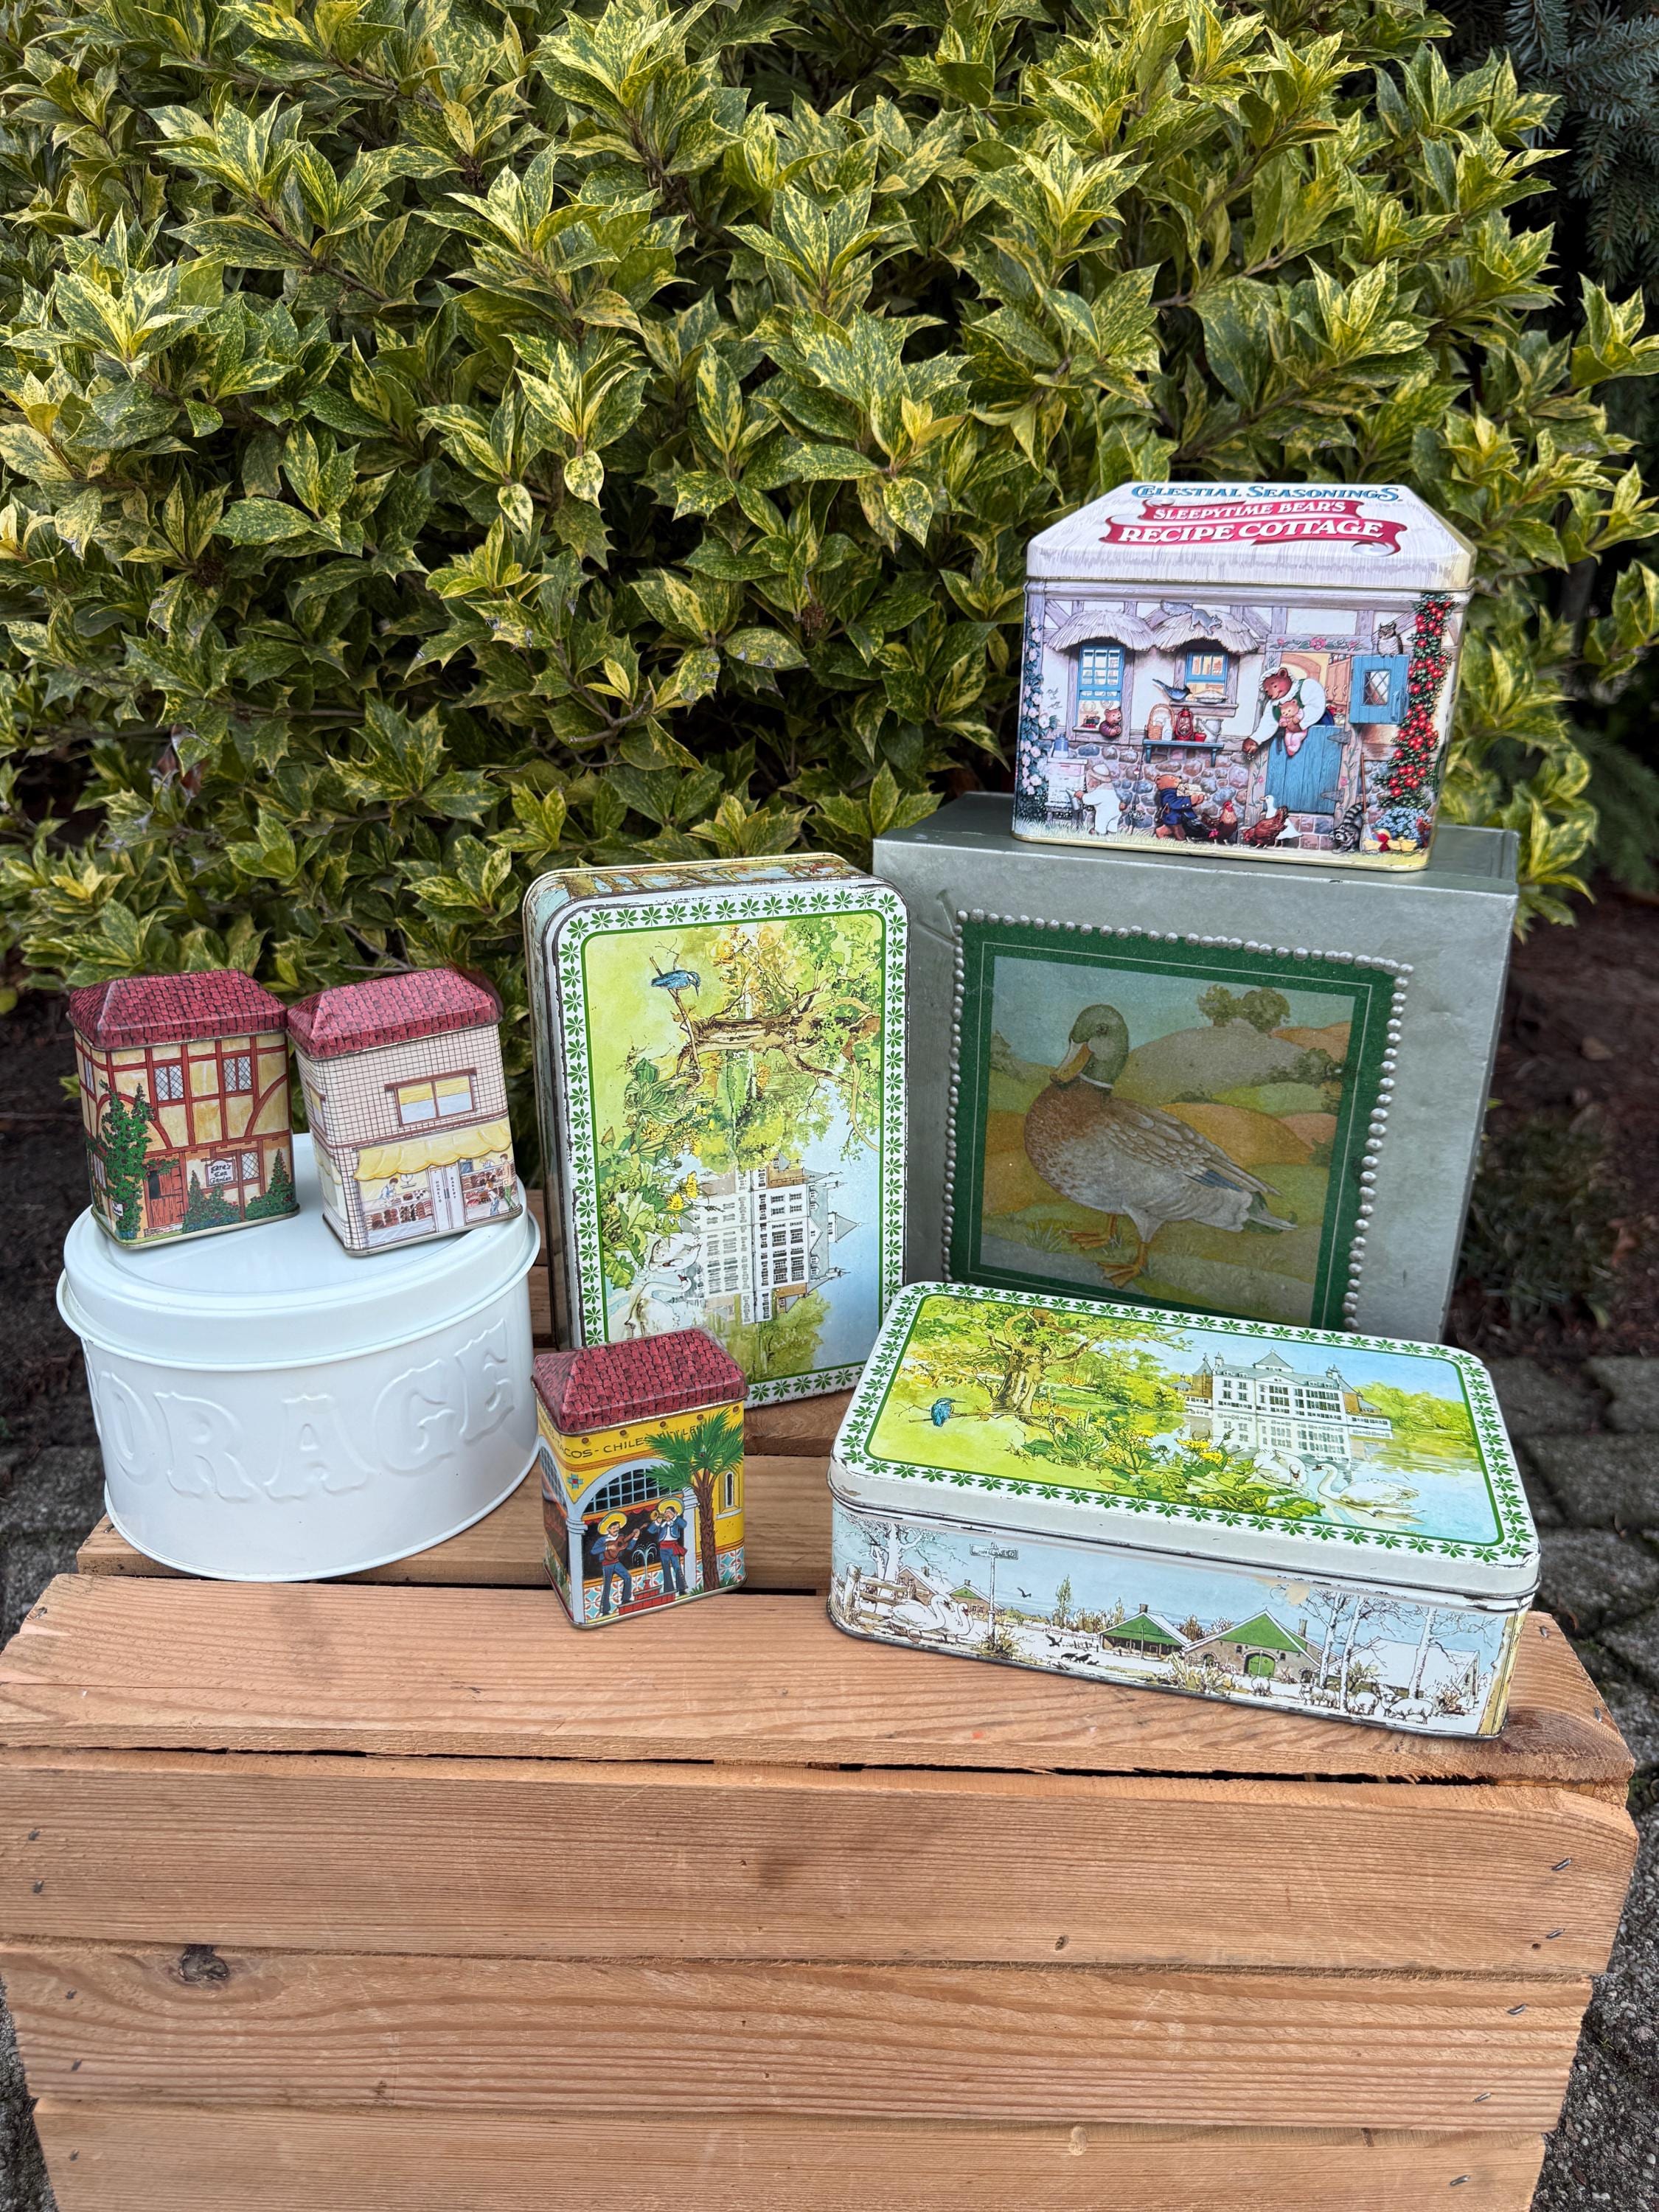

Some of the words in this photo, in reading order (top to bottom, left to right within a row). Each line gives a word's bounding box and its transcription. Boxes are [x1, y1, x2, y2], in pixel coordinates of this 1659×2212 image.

[1132, 485, 1242, 498] CELESTIAL
[1247, 486, 1399, 502] SEASONINGS
[1153, 504, 1274, 520] SLEEPYTIME
[1277, 501, 1346, 514] BEAR'S
[1118, 524, 1236, 543] RECIPE
[1239, 520, 1385, 538] COTTAGE
[97, 1318, 515, 1503] ORAGE
